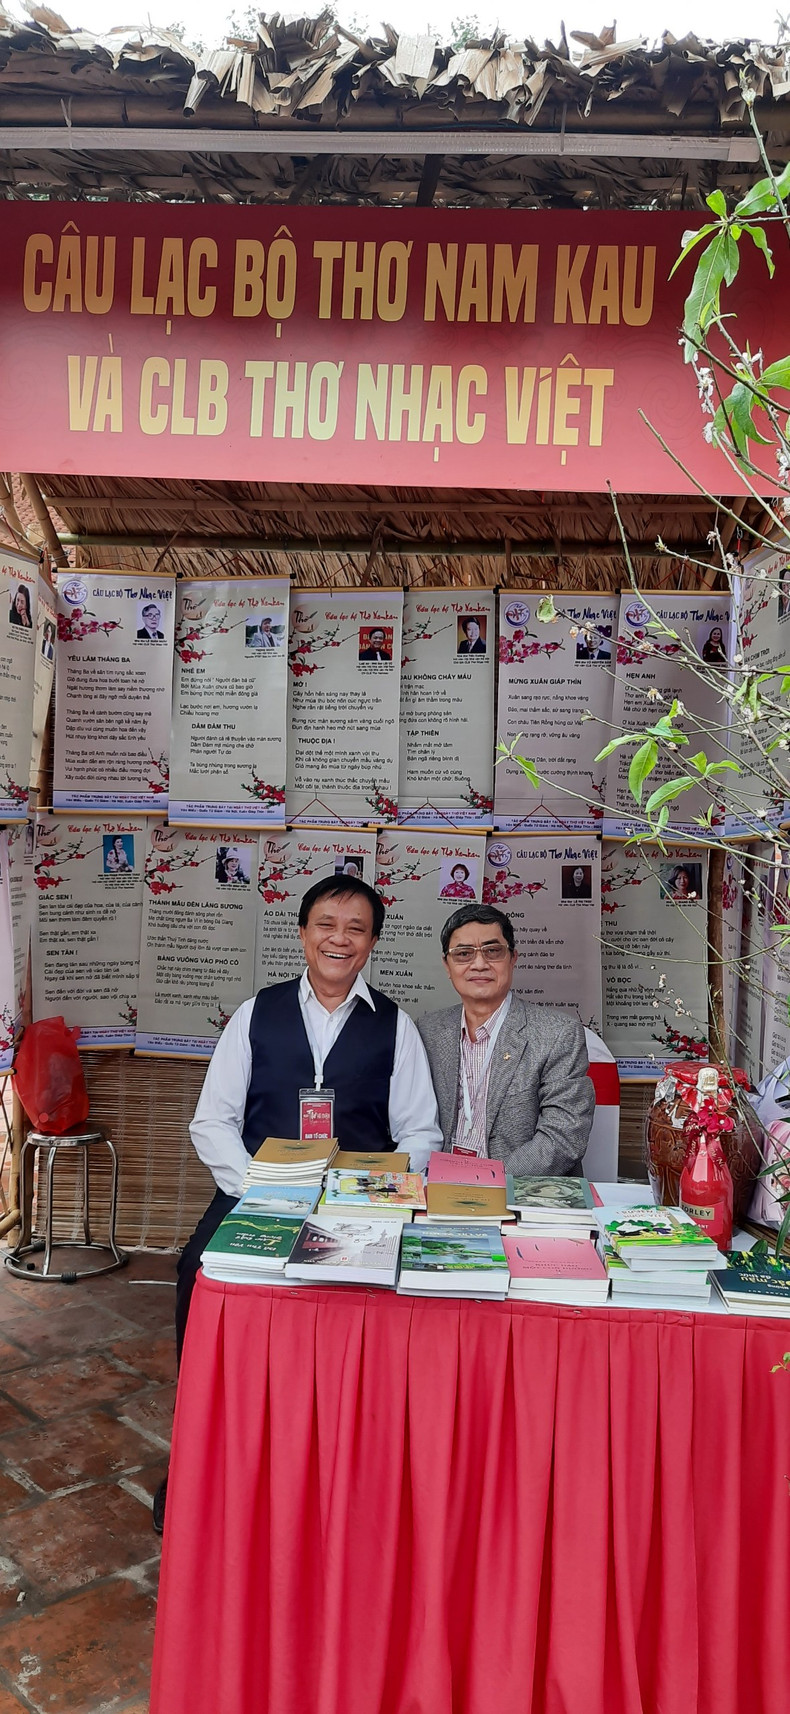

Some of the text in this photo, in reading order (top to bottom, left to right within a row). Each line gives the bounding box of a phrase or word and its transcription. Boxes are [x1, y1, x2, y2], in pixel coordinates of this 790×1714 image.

[22, 220, 657, 338] CÂU LẠC BỘ THƠ NAM KAU
[67, 333, 122, 433] VÀ
[138, 356, 230, 437] CLB
[244, 360, 345, 439] THƠ
[354, 363, 488, 463] NHẠC
[93, 588, 104, 596] CÂU
[105, 590, 115, 598] LẠC
[116, 589, 123, 598] BỘ
[157, 589, 173, 601] Việt
[517, 850, 528, 858] CÂU
[528, 851, 539, 859] LẠC
[540, 849, 547, 859] BỘ
[582, 849, 598, 860] Việt
